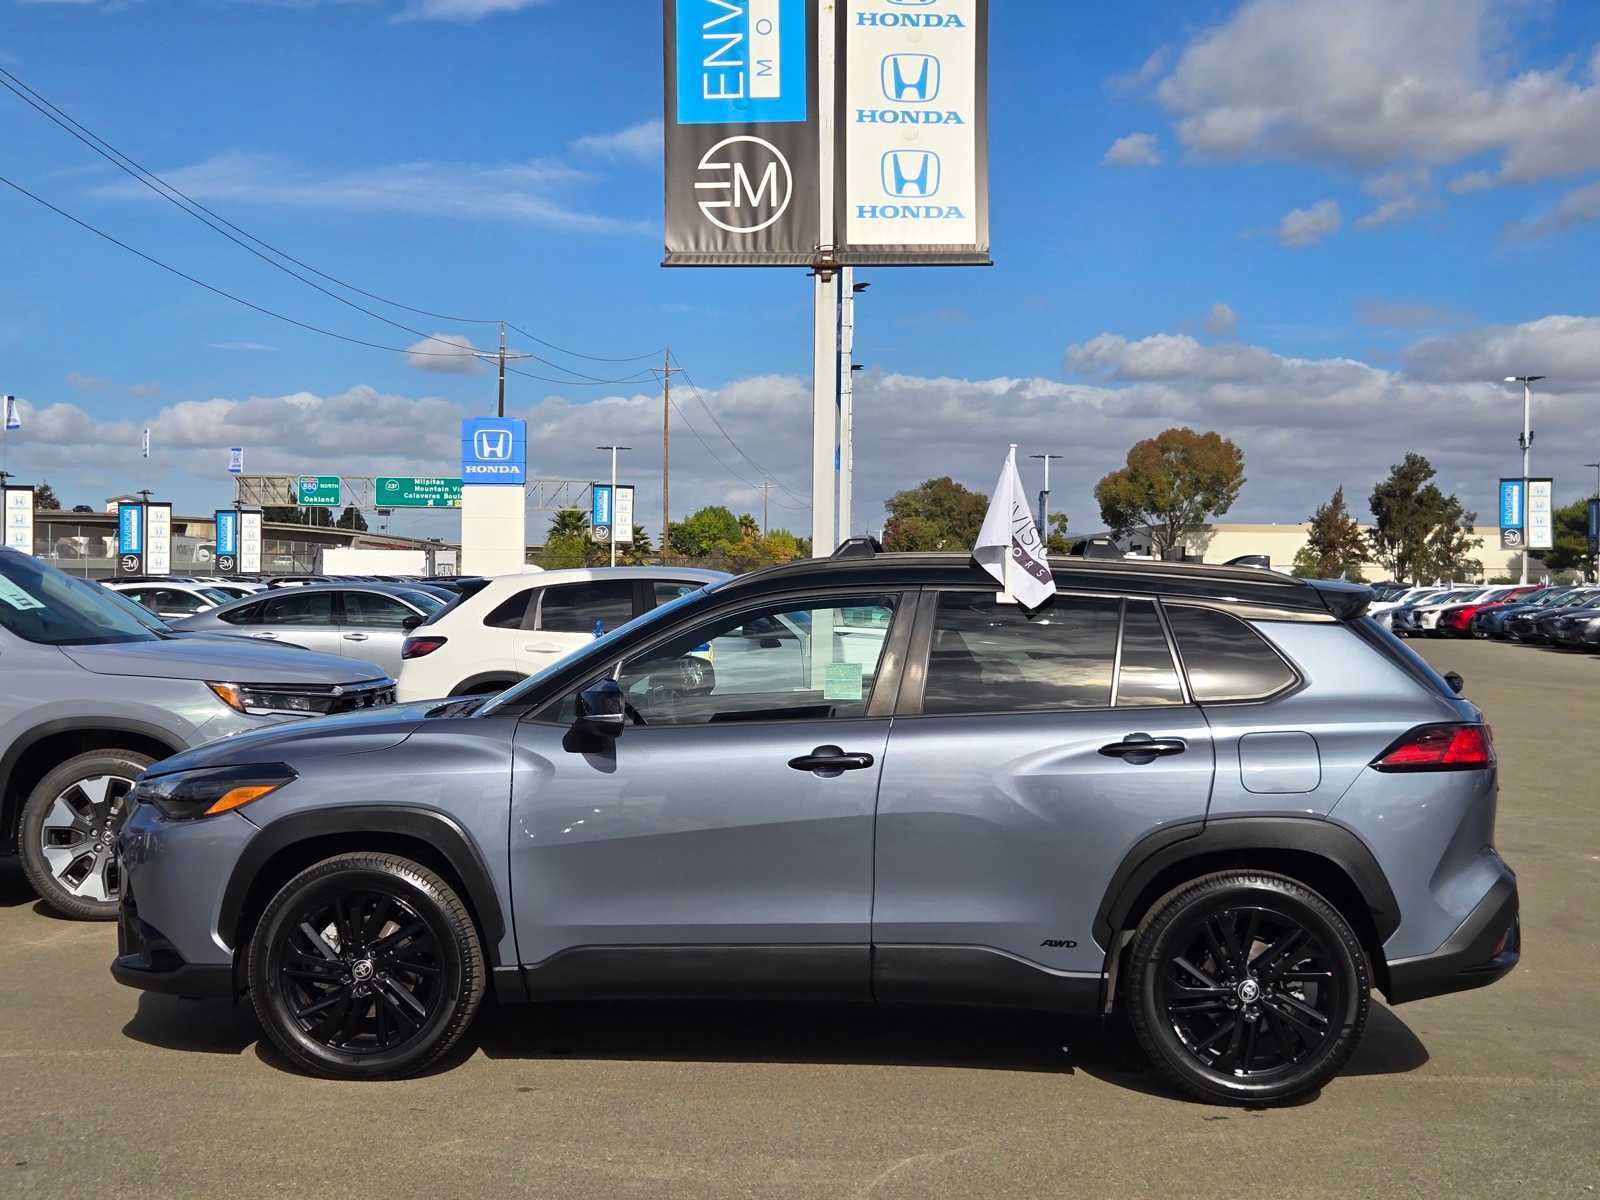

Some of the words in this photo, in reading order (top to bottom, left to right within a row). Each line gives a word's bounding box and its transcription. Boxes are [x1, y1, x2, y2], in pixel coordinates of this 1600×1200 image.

[856, 12, 966, 28] HONDA
[856, 109, 965, 124] HONDA
[856, 205, 966, 219] HONDA
[465, 465, 520, 473] HONDA
[1504, 485, 1513, 525] ENVISION
[123, 509, 132, 550] ENVISION
[1040, 939, 1078, 948] AWD
